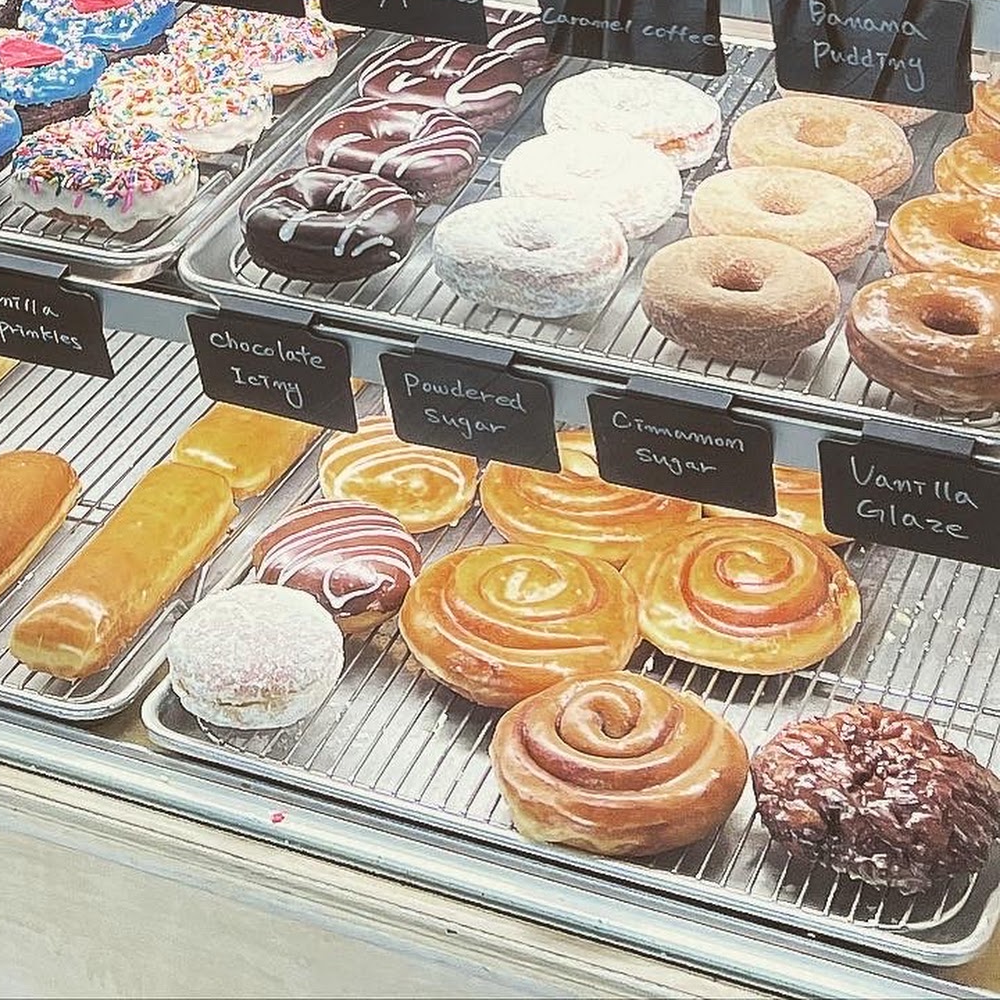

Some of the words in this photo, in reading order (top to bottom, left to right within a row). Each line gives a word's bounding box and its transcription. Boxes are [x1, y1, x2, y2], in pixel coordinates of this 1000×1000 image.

[541, 7, 631, 35] Caramel
[230, 365, 304, 409] Icing
[403, 371, 527, 415] Powdered
[611, 410, 746, 453] Cinnamon
[850, 455, 979, 510] Vanilla
[855, 499, 970, 540] Glaze
